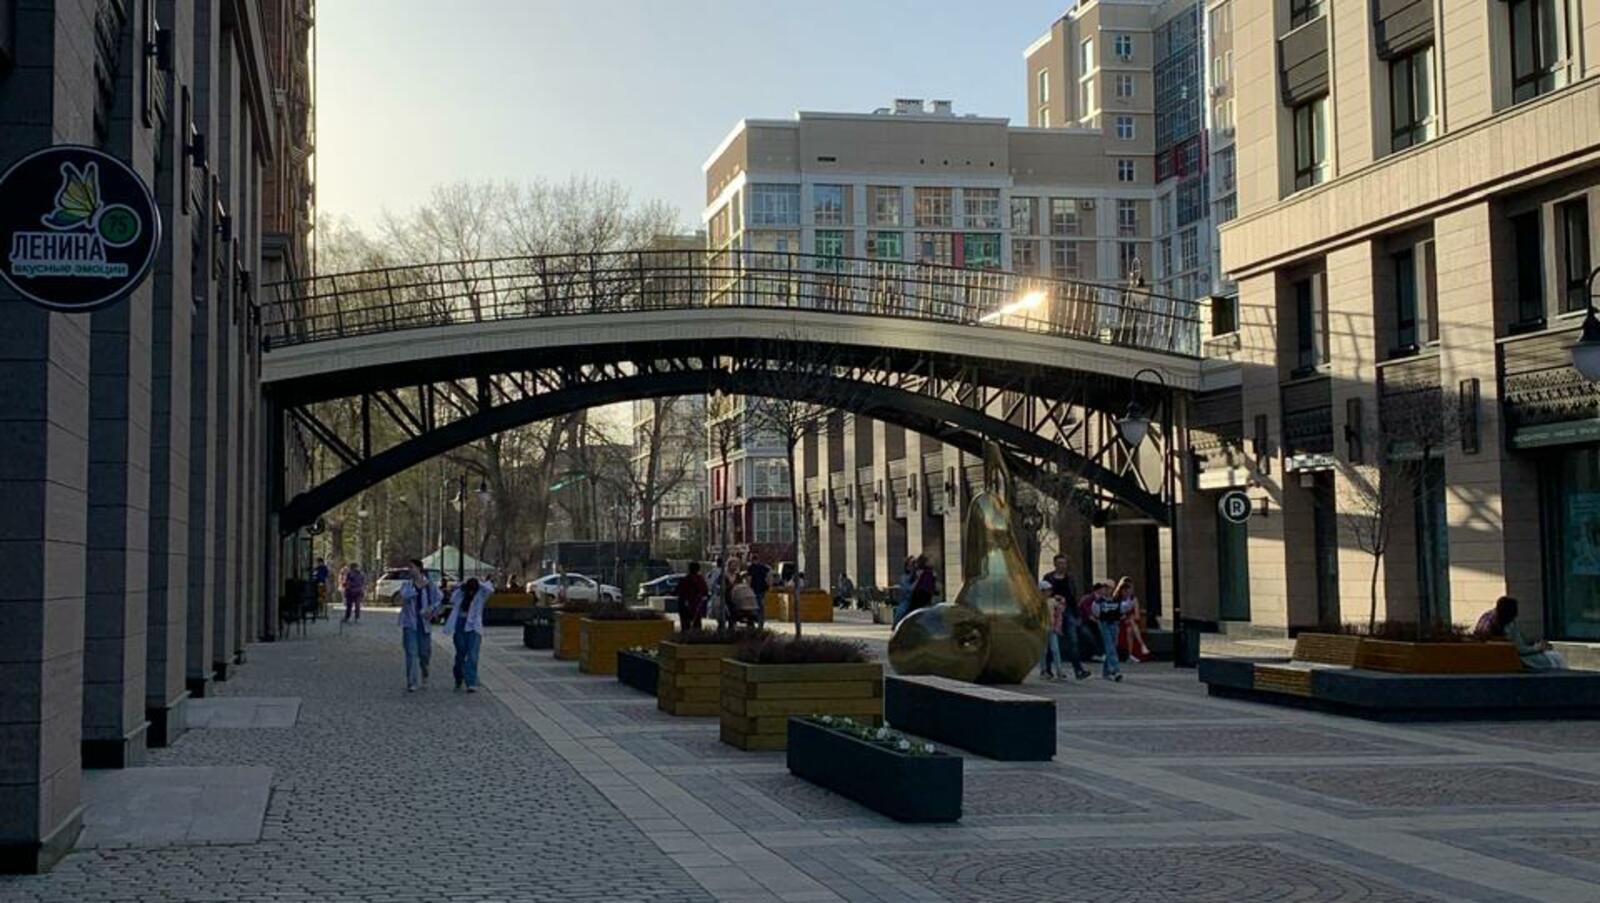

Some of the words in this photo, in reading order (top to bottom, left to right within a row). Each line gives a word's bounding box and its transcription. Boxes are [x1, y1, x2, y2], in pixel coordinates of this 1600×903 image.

[109, 216, 128, 235] 75
[11, 234, 104, 260] ЛЕНИНА
[14, 264, 71, 275] вкусные
[74, 264, 126, 275] эмоции
